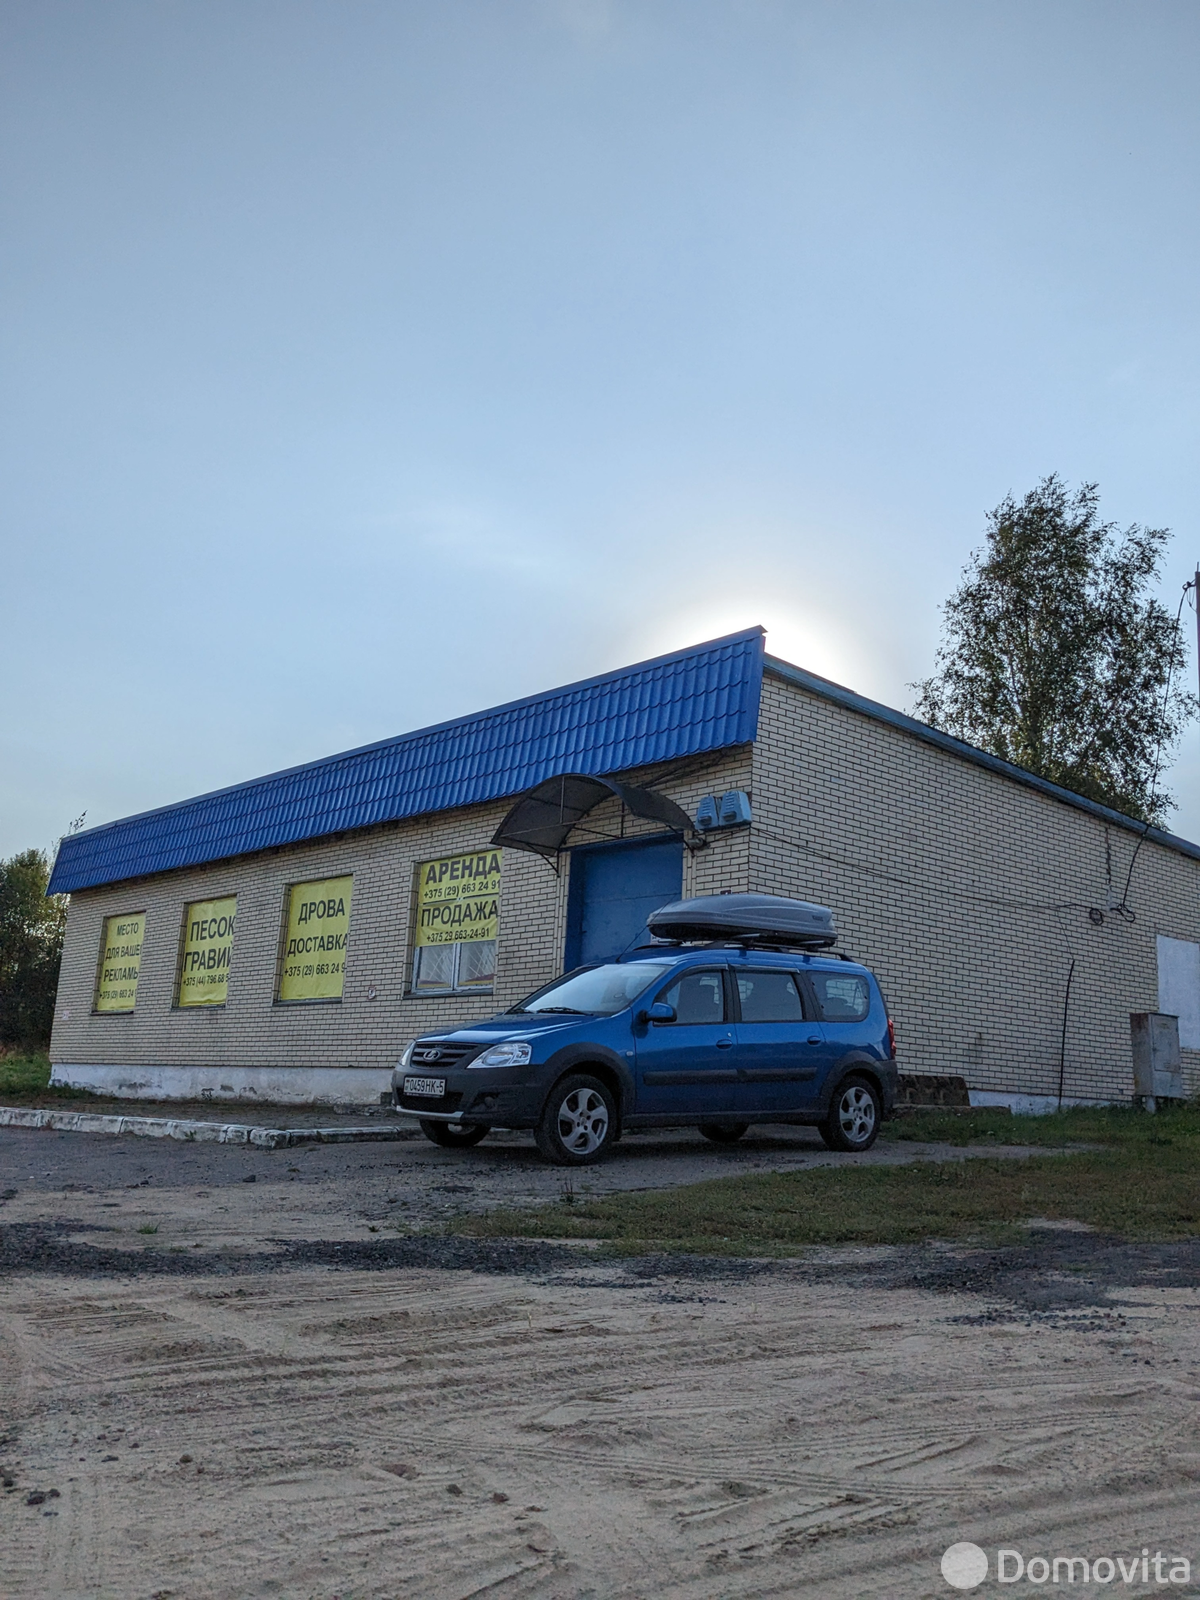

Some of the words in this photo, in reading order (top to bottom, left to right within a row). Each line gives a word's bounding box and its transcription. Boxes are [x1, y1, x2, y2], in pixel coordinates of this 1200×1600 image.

[425, 853, 501, 885] АРЕНДА
[424, 888, 442, 899] +375
[444, 885, 460, 898] (29)
[461, 883, 476, 894] 663
[478, 881, 489, 891] 24
[297, 898, 345, 925] ДРОВА
[421, 900, 498, 927] ПРОДАЖА
[117, 922, 139, 936] МЕСТО
[190, 915, 236, 942] ПЕСОК
[426, 932, 443, 943] +375
[444, 931, 453, 941] 29
[454, 927, 490, 941] 663-24-91
[105, 946, 119, 961] ДЛЯ
[121, 944, 142, 958] ВАШЕ
[287, 933, 348, 958] ДОСТАВКА
[284, 965, 301, 977] +375
[302, 964, 315, 978] (29)
[316, 963, 329, 975] 663
[331, 962, 340, 974] 24
[183, 976, 196, 986] +375
[196, 976, 206, 987] (44)
[100, 991, 110, 999] +375
[127, 989, 134, 998] 24
